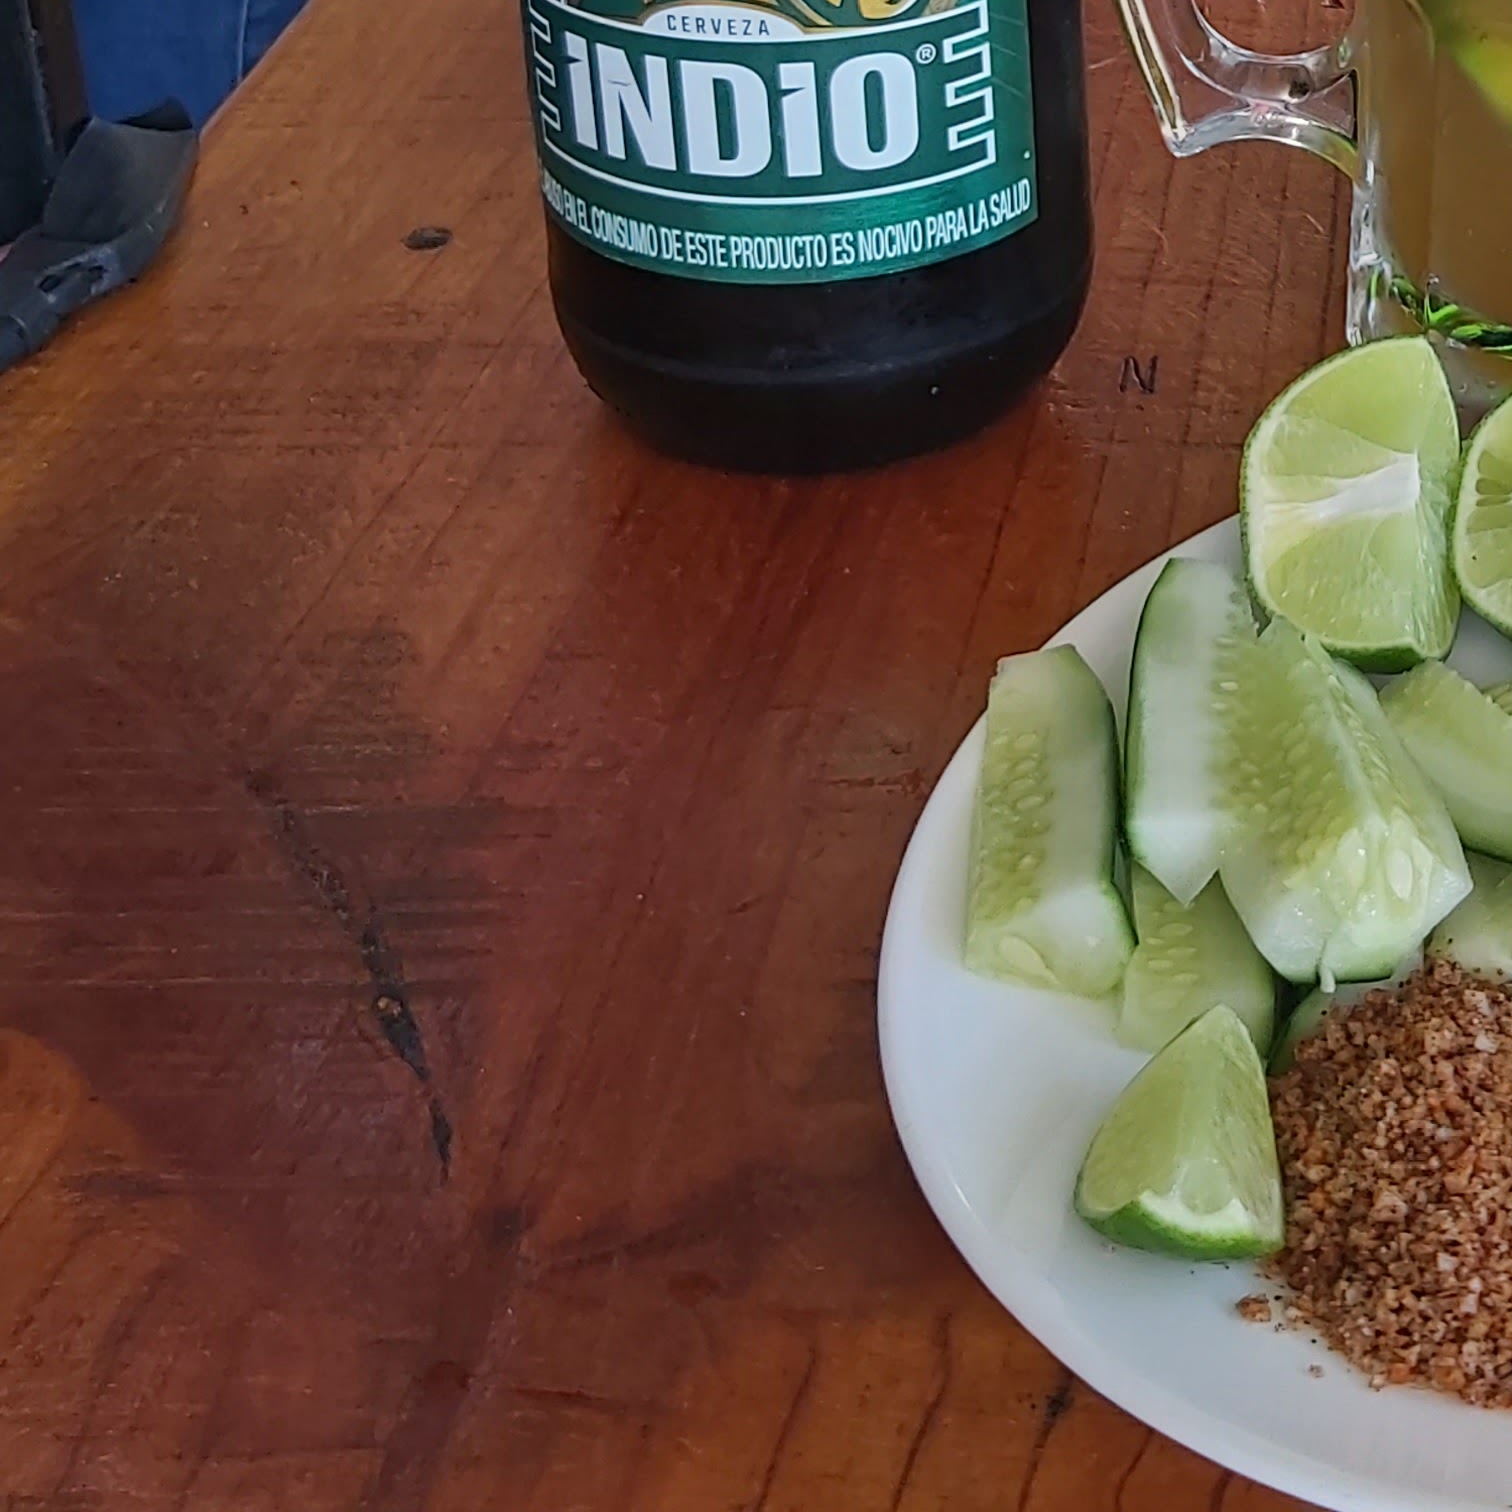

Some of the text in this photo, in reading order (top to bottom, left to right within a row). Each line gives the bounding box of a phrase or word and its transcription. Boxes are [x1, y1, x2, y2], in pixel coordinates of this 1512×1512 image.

[667, 14, 771, 36] CERVEZA
[591, 205, 659, 258] CONSUMO
[659, 226, 685, 261] DE
[686, 231, 728, 268] ESTE
[731, 234, 828, 270] PRODUCTO
[831, 231, 856, 266] ES
[858, 220, 923, 263] NOCIVO
[925, 206, 969, 250] PARA
[968, 199, 989, 236] LA
[990, 177, 1031, 227] SALUD
